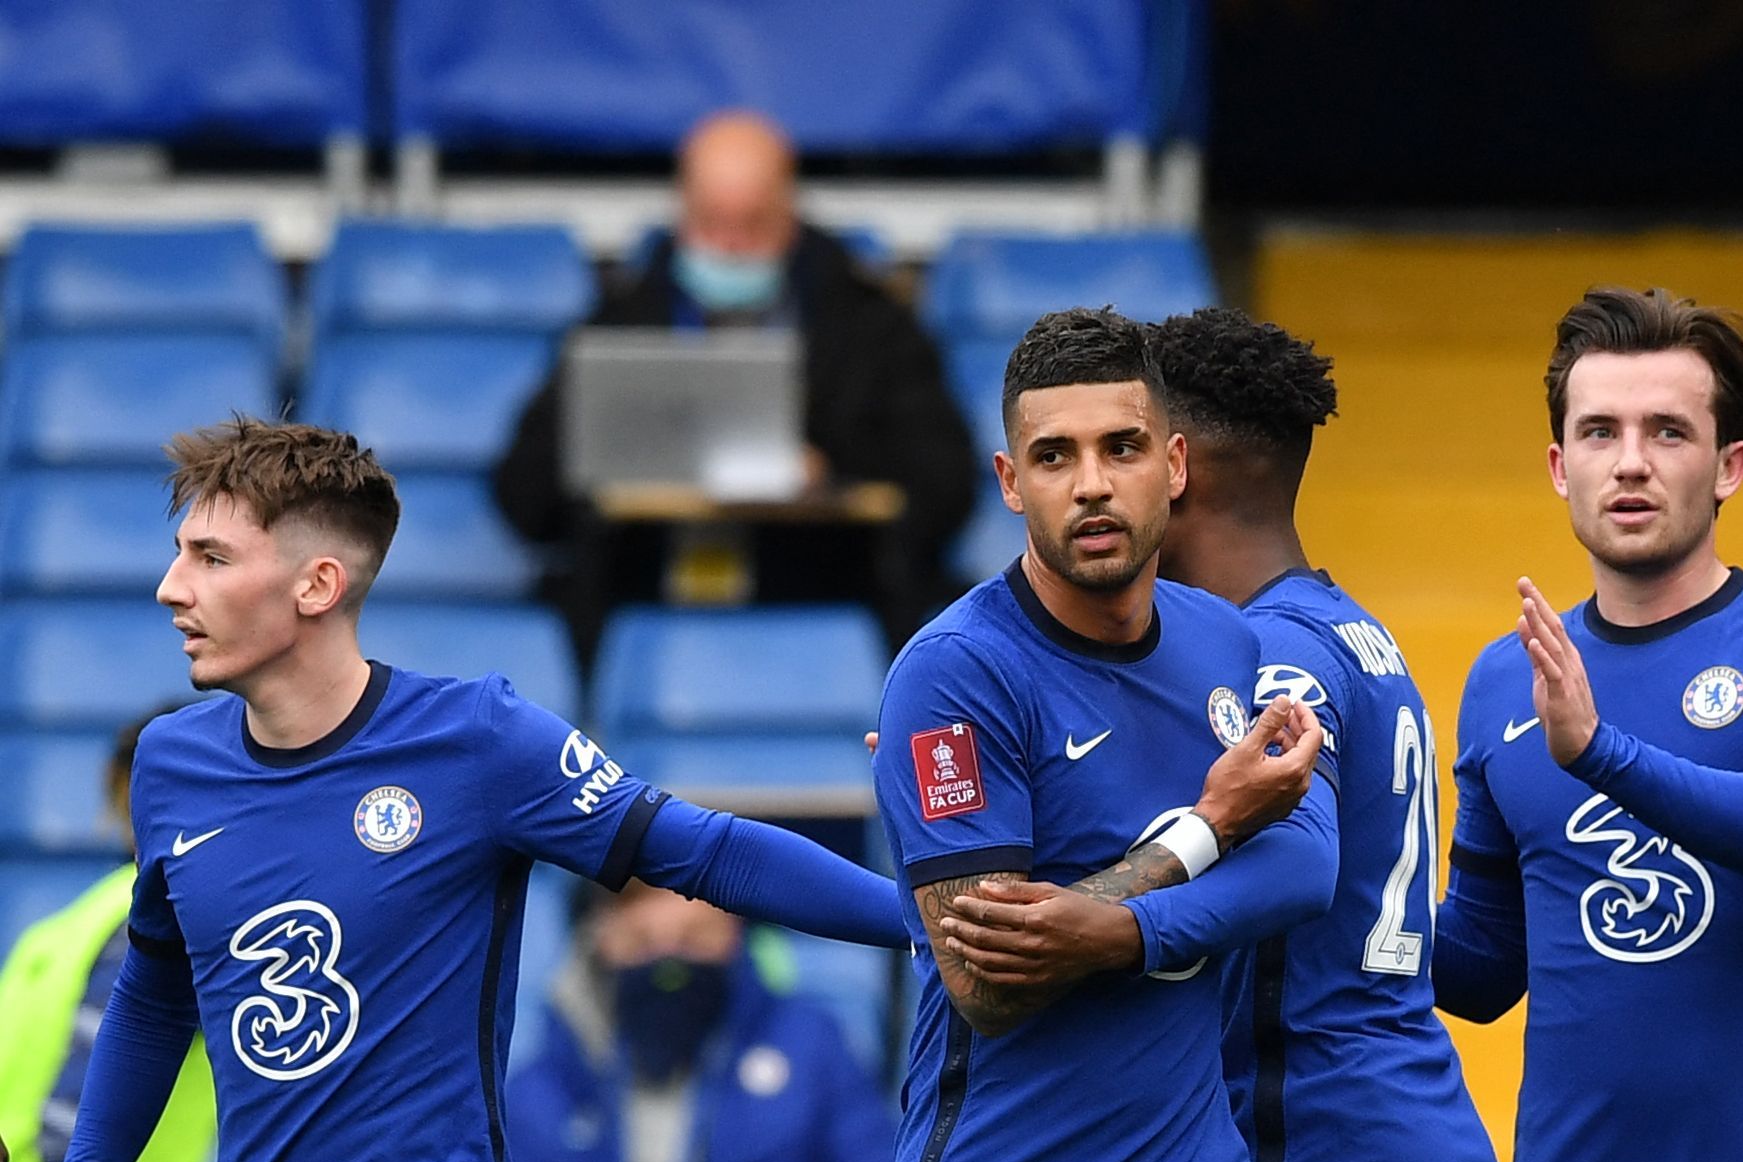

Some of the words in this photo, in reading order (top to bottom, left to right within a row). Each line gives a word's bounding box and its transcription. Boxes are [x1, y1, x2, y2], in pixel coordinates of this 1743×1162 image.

[926, 779, 974, 797] Emirates
[929, 795, 947, 810] FA
[946, 789, 976, 805] CUP
